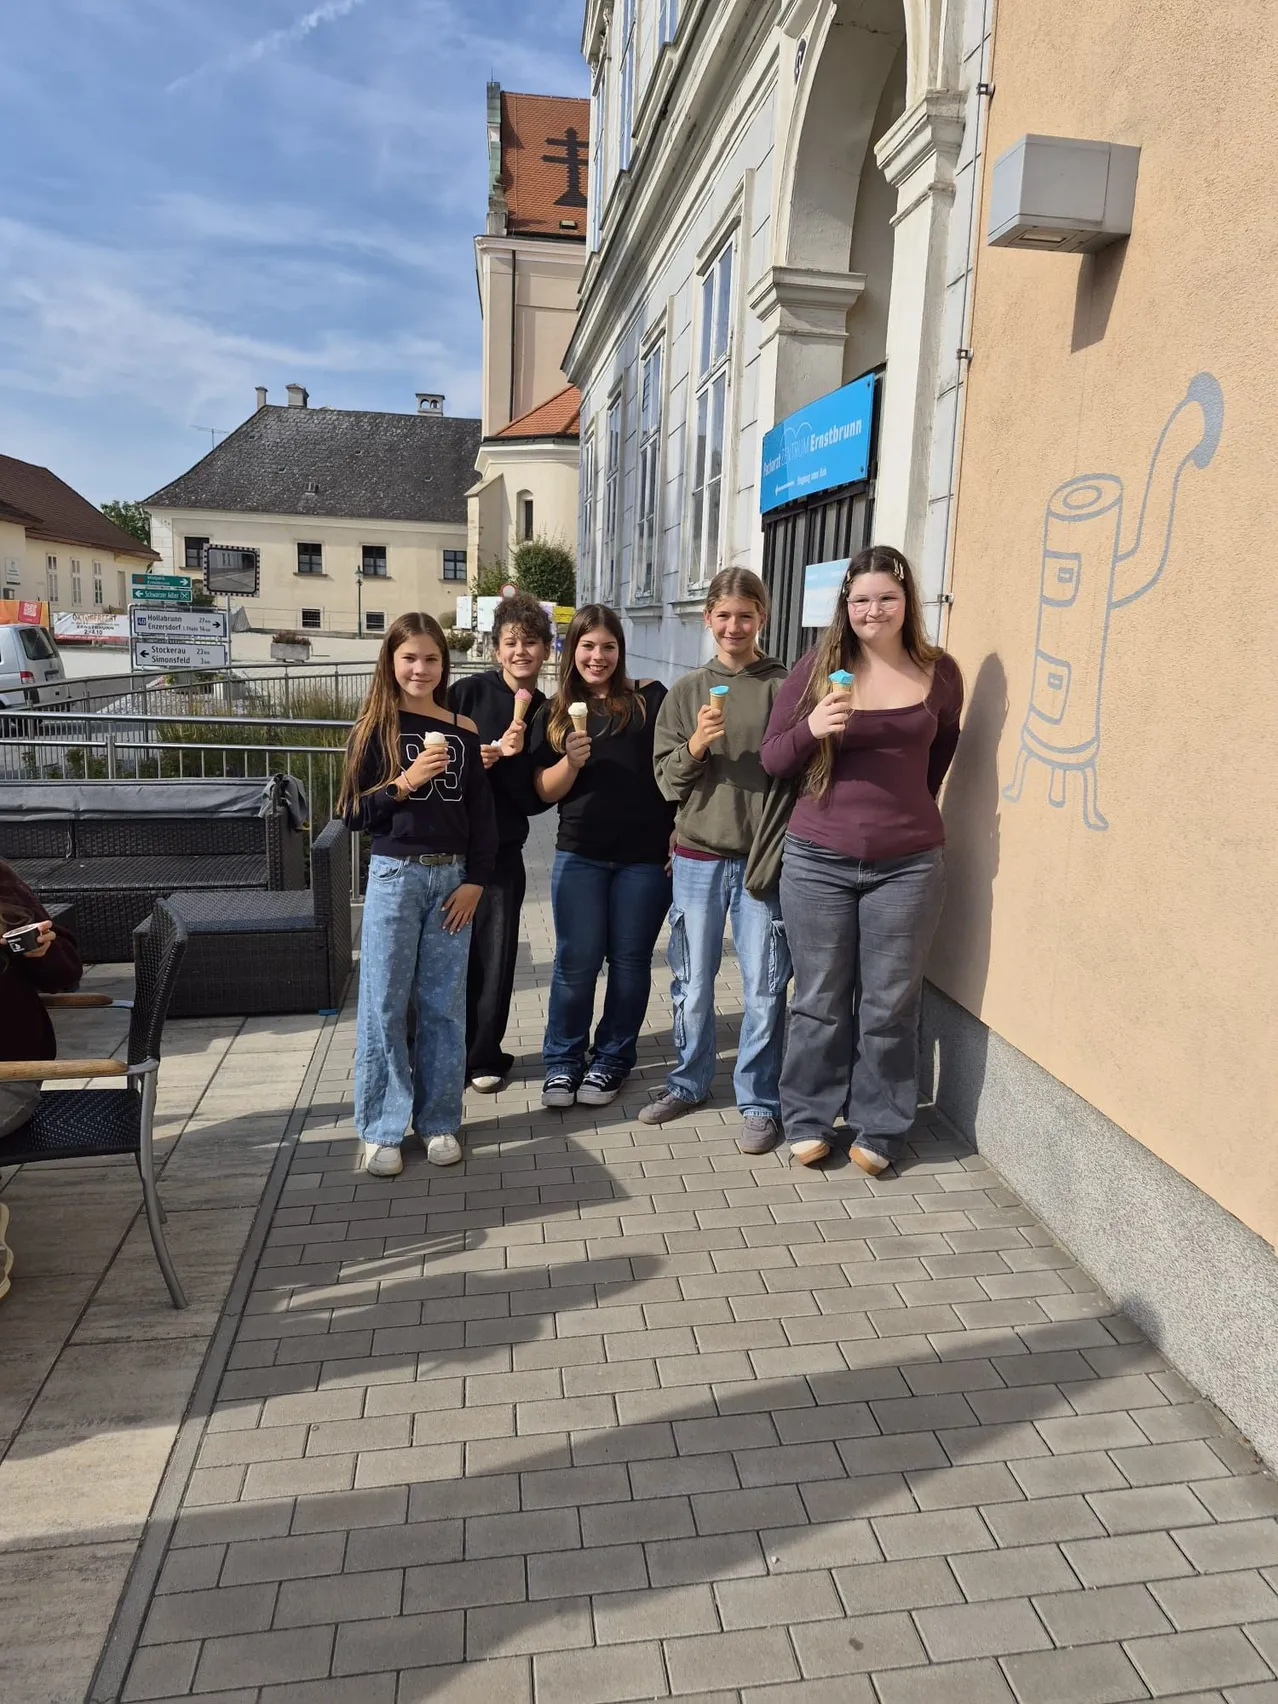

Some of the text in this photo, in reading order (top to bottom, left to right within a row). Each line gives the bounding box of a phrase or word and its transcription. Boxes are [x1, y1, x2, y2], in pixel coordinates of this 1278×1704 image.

[810, 418, 862, 452] Ernstbrunn
[144, 590, 167, 598] Schwarzer
[138, 618, 146, 626] 40
[147, 614, 183, 623] Hollabrunn
[147, 623, 182, 632] Enzersdorf
[151, 645, 186, 655] Stockerau
[151, 655, 191, 664] Simonsfeld
